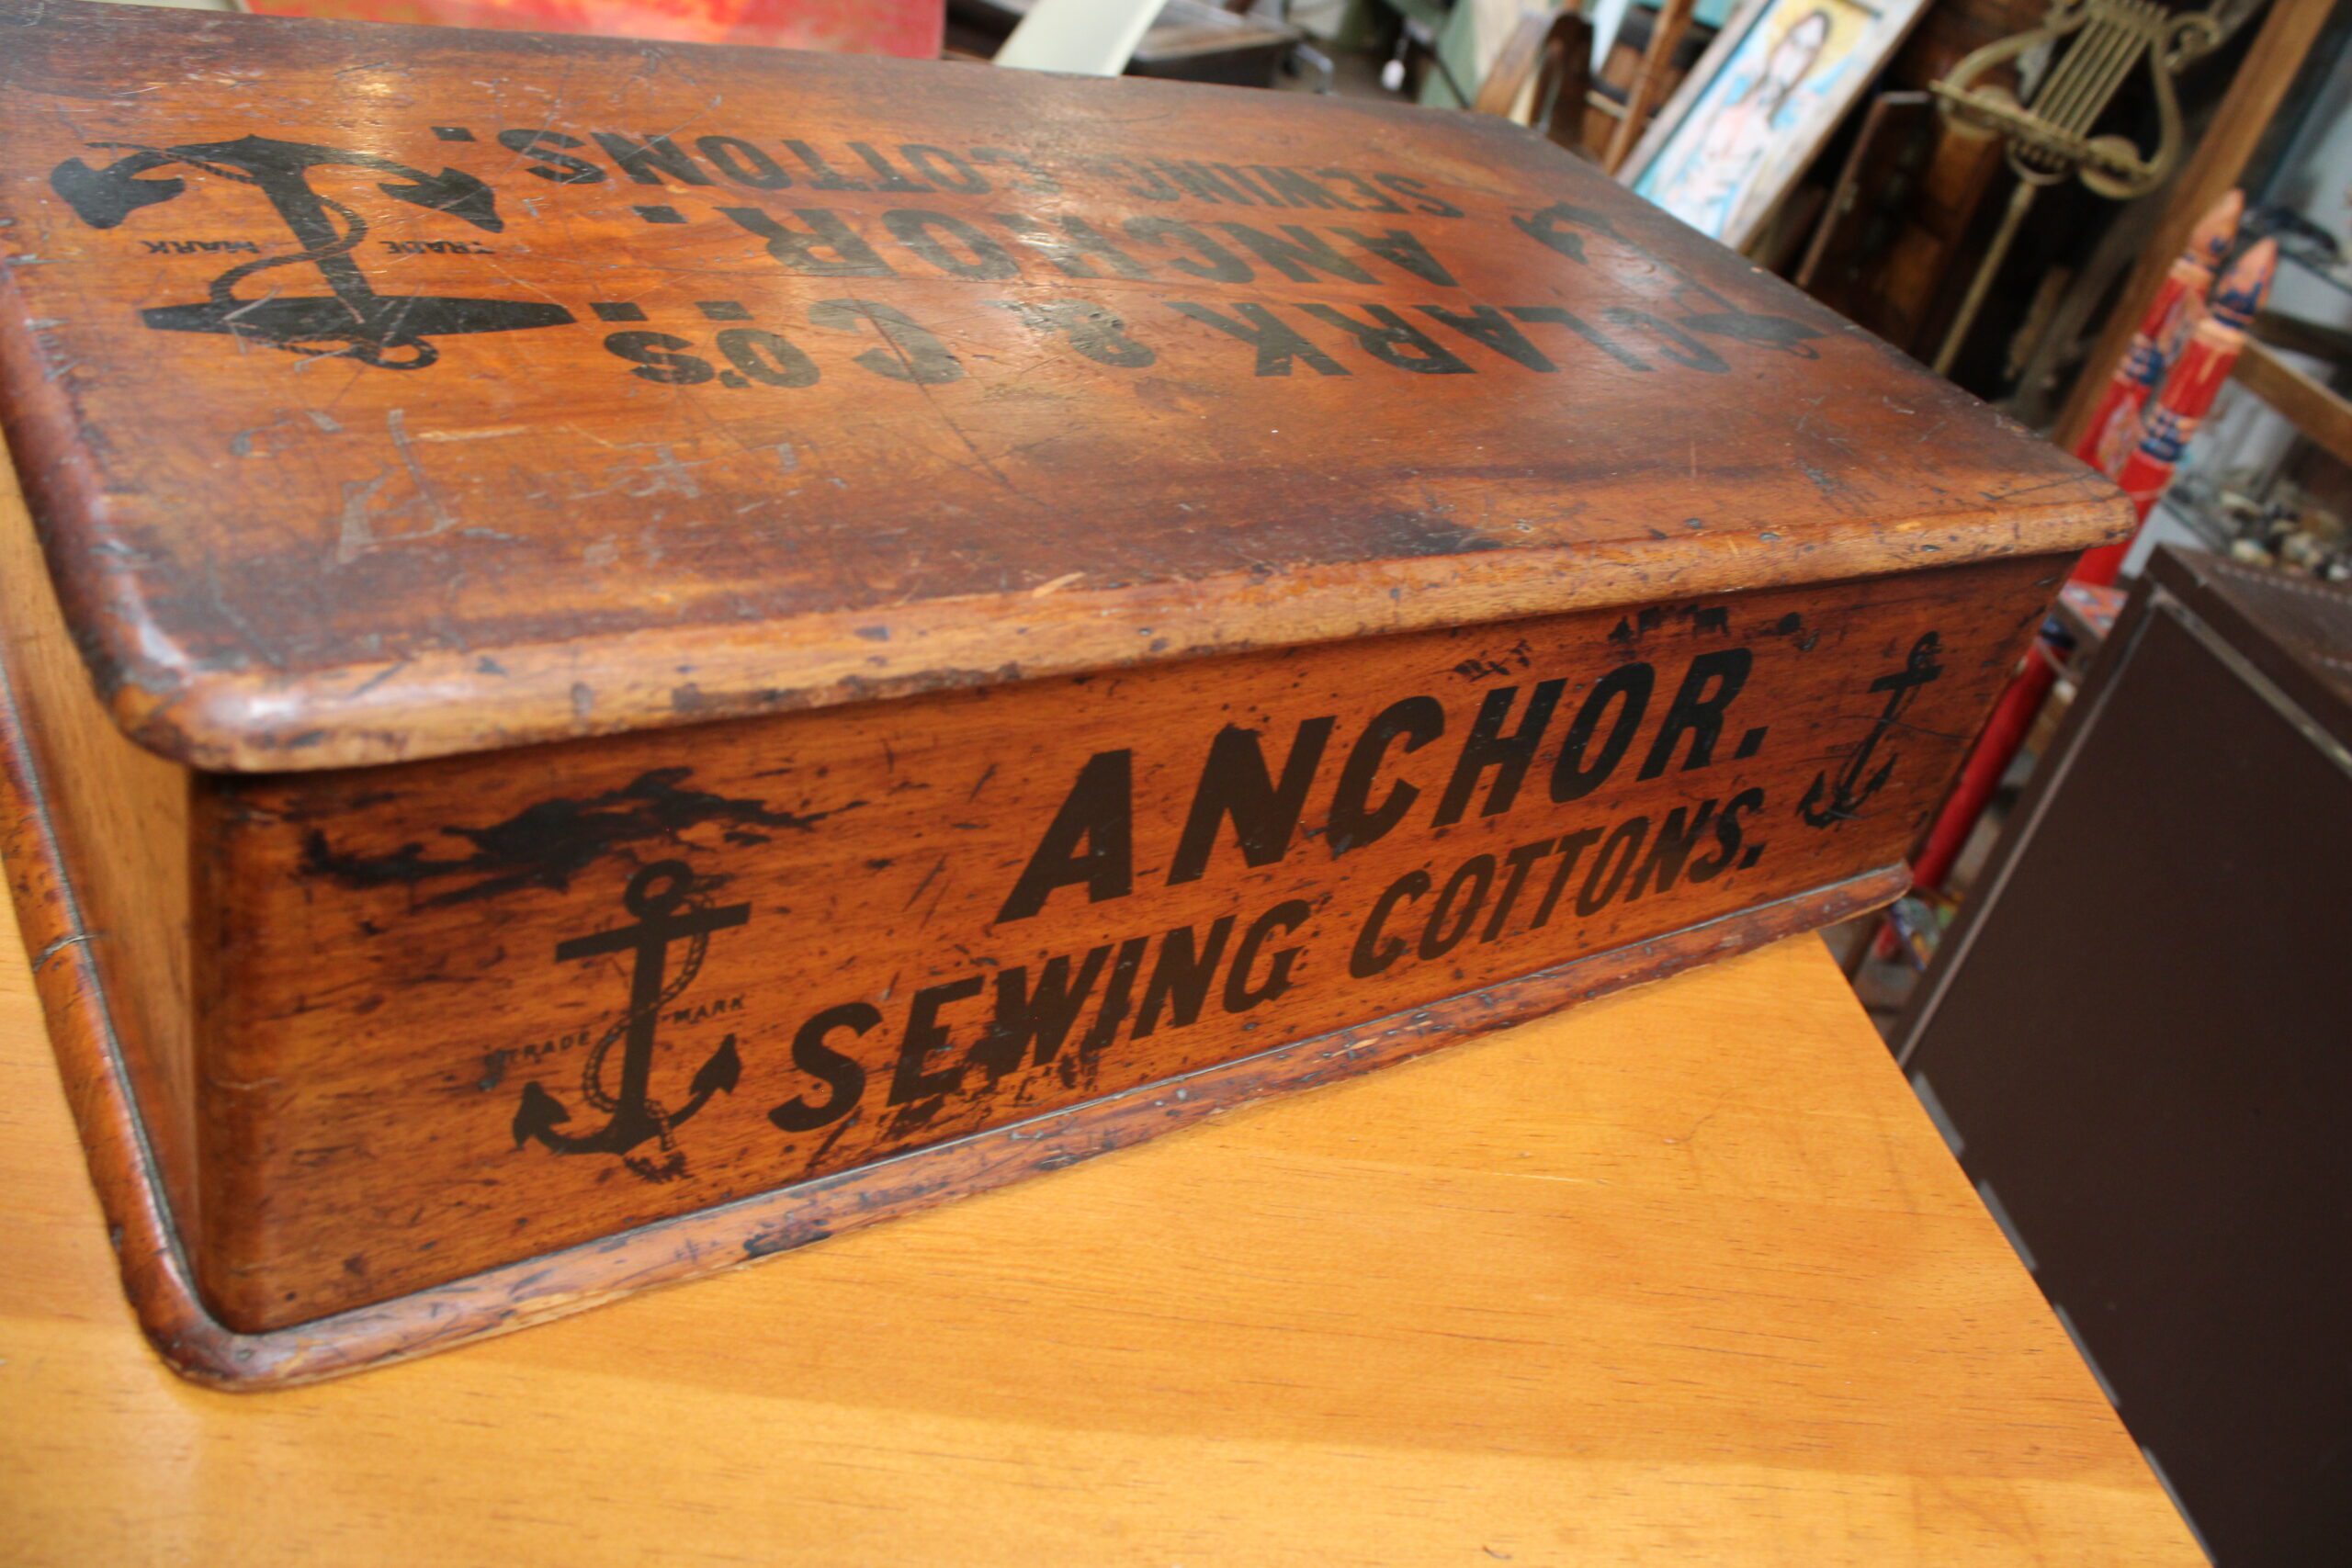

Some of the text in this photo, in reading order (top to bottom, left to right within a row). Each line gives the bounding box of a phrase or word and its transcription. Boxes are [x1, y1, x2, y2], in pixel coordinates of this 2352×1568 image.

[1084, 152, 1464, 219] SEWING
[141, 239, 496, 255] TRADE MARK
[978, 299, 1156, 368] &
[1161, 300, 1732, 378] CLARK
[994, 645, 1769, 924] ANCHOR.
[767, 786, 1766, 1134] SEWING COTTONS.
[507, 993, 746, 1062] TRADE MARK
